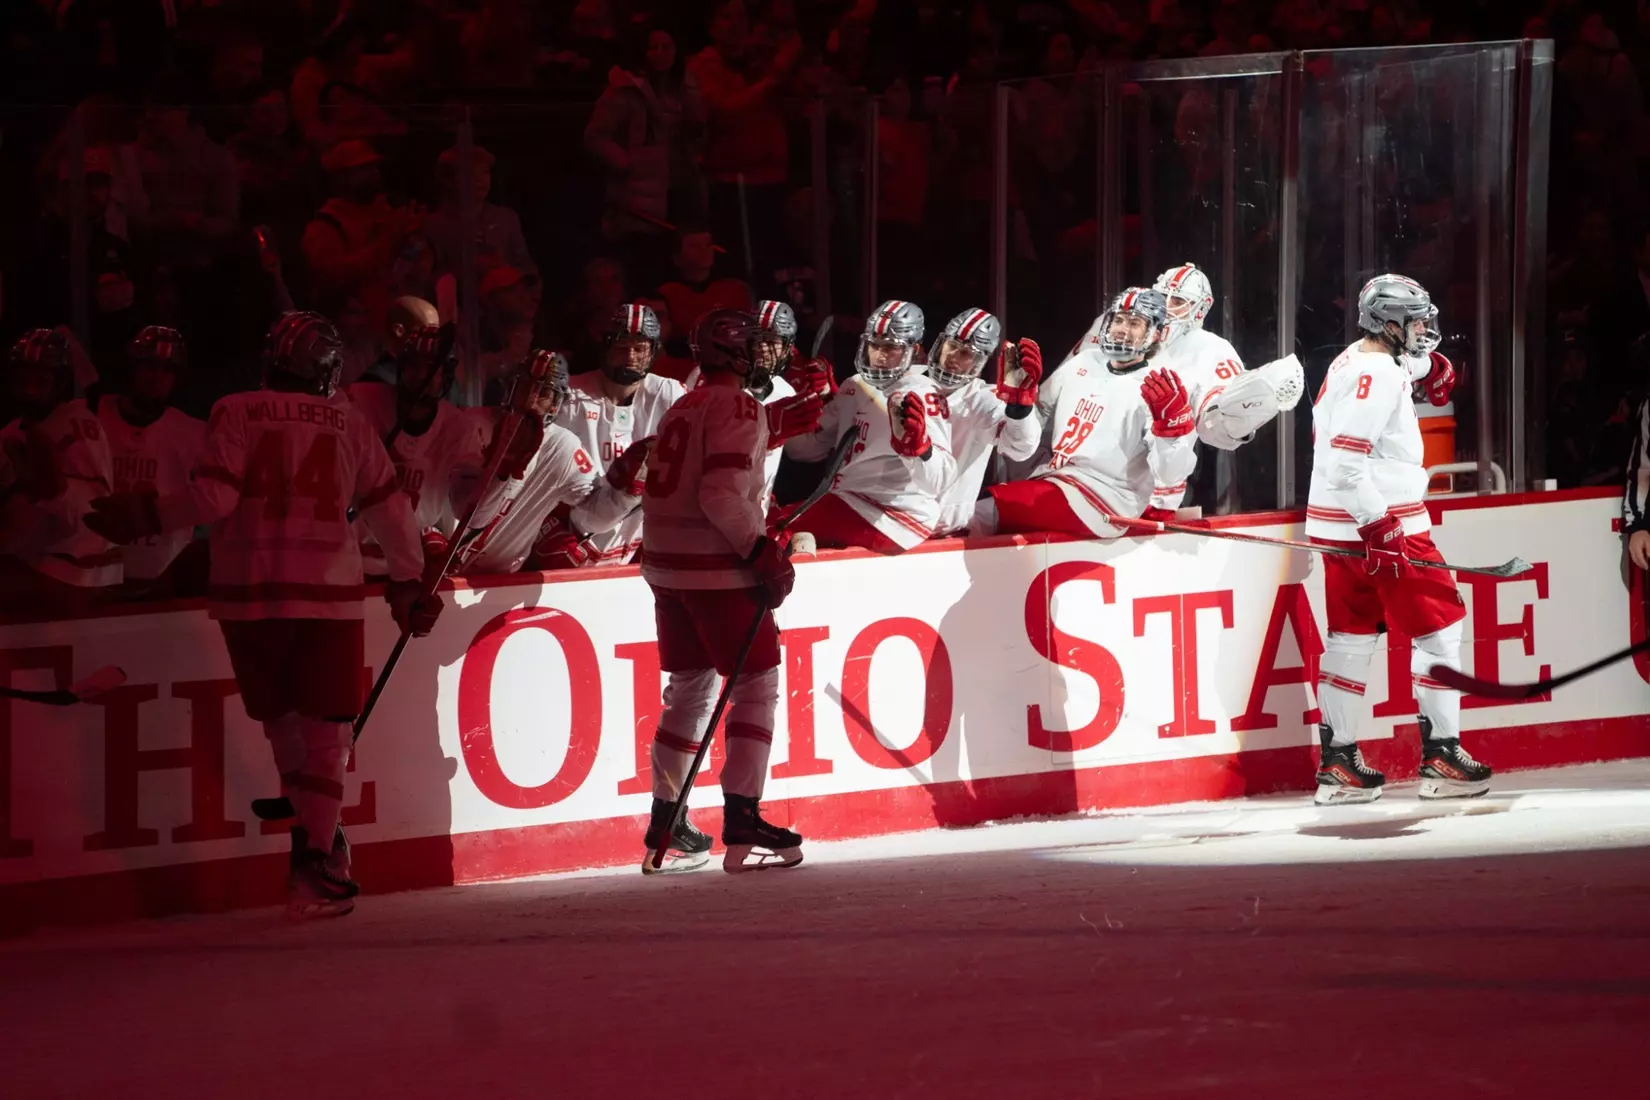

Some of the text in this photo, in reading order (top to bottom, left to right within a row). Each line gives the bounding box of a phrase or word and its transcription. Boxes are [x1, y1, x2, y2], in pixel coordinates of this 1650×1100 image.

[1356, 374, 1373, 400] 8
[245, 401, 345, 431] WALLBERG
[734, 395, 759, 421] 19
[1074, 398, 1105, 424] OHIO
[1053, 416, 1094, 456] 28
[573, 448, 594, 475] 9
[240, 431, 342, 523] 44
[1332, 767, 1352, 784] CCM
[1434, 758, 1463, 781] CCM
